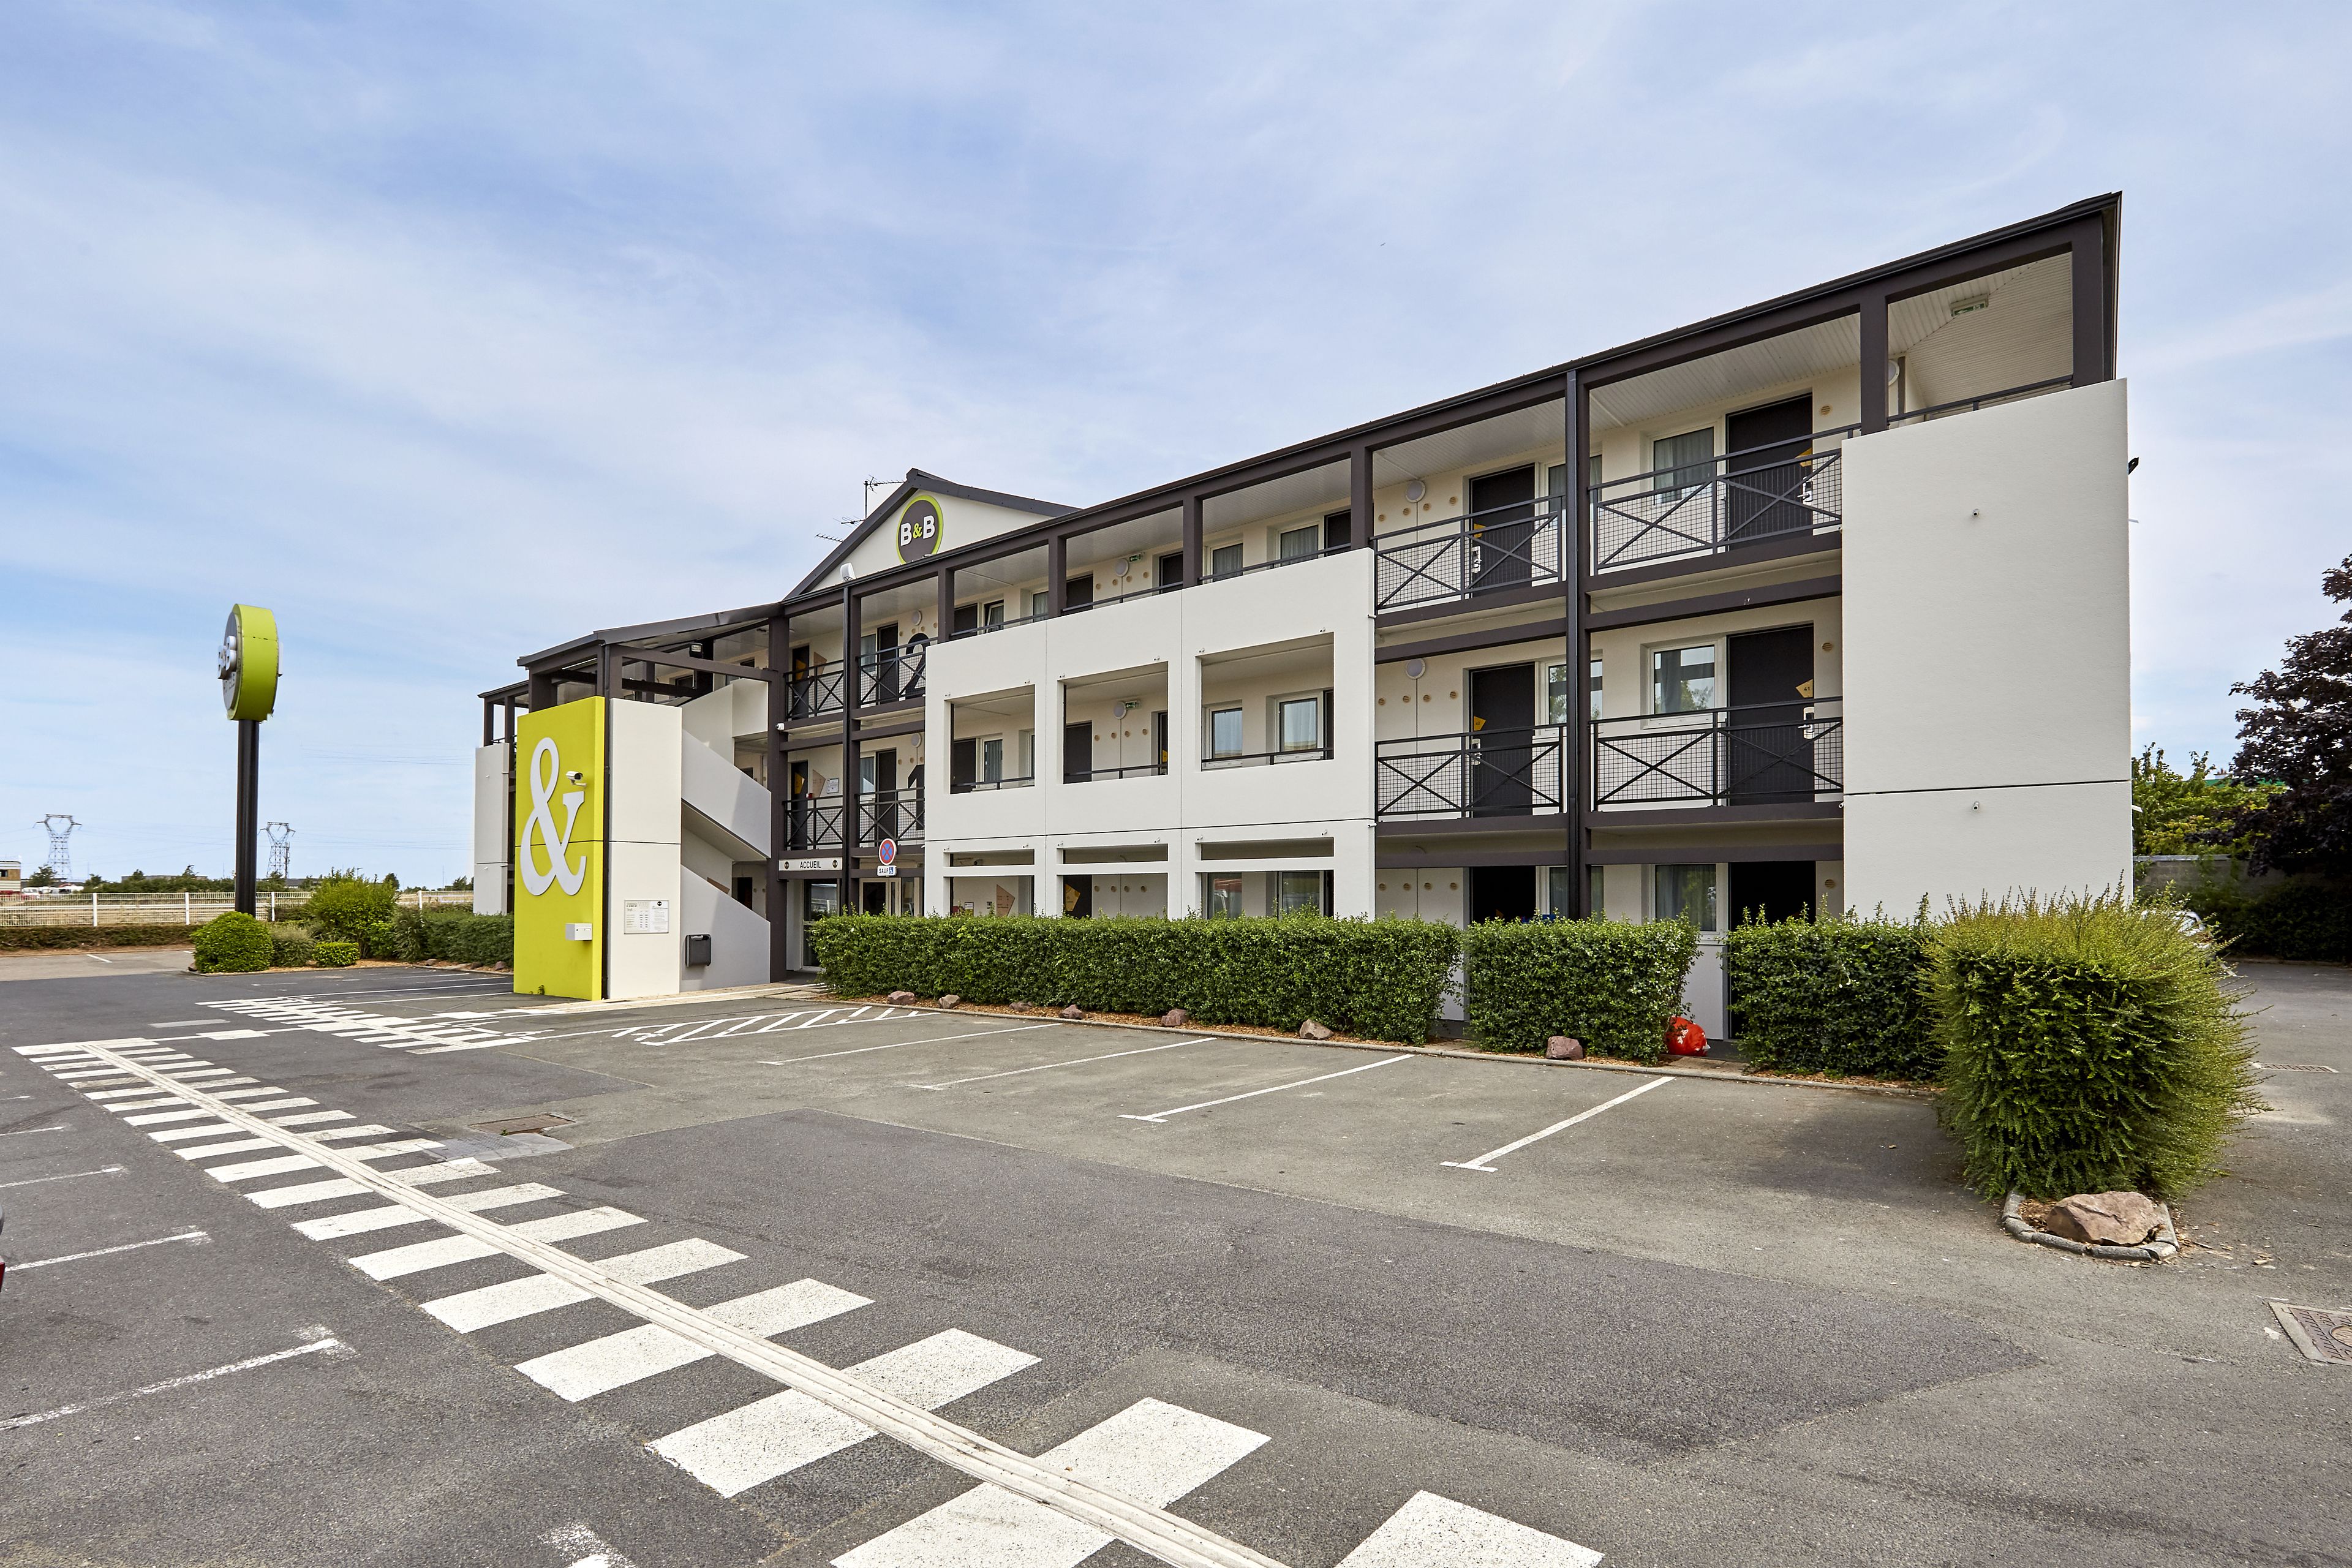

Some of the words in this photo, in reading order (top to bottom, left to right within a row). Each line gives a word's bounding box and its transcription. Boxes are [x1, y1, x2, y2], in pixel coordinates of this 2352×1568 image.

[900, 515, 935, 546] B&B
[905, 632, 930, 696] 2
[520, 737, 587, 896] &
[908, 764, 924, 830] 1
